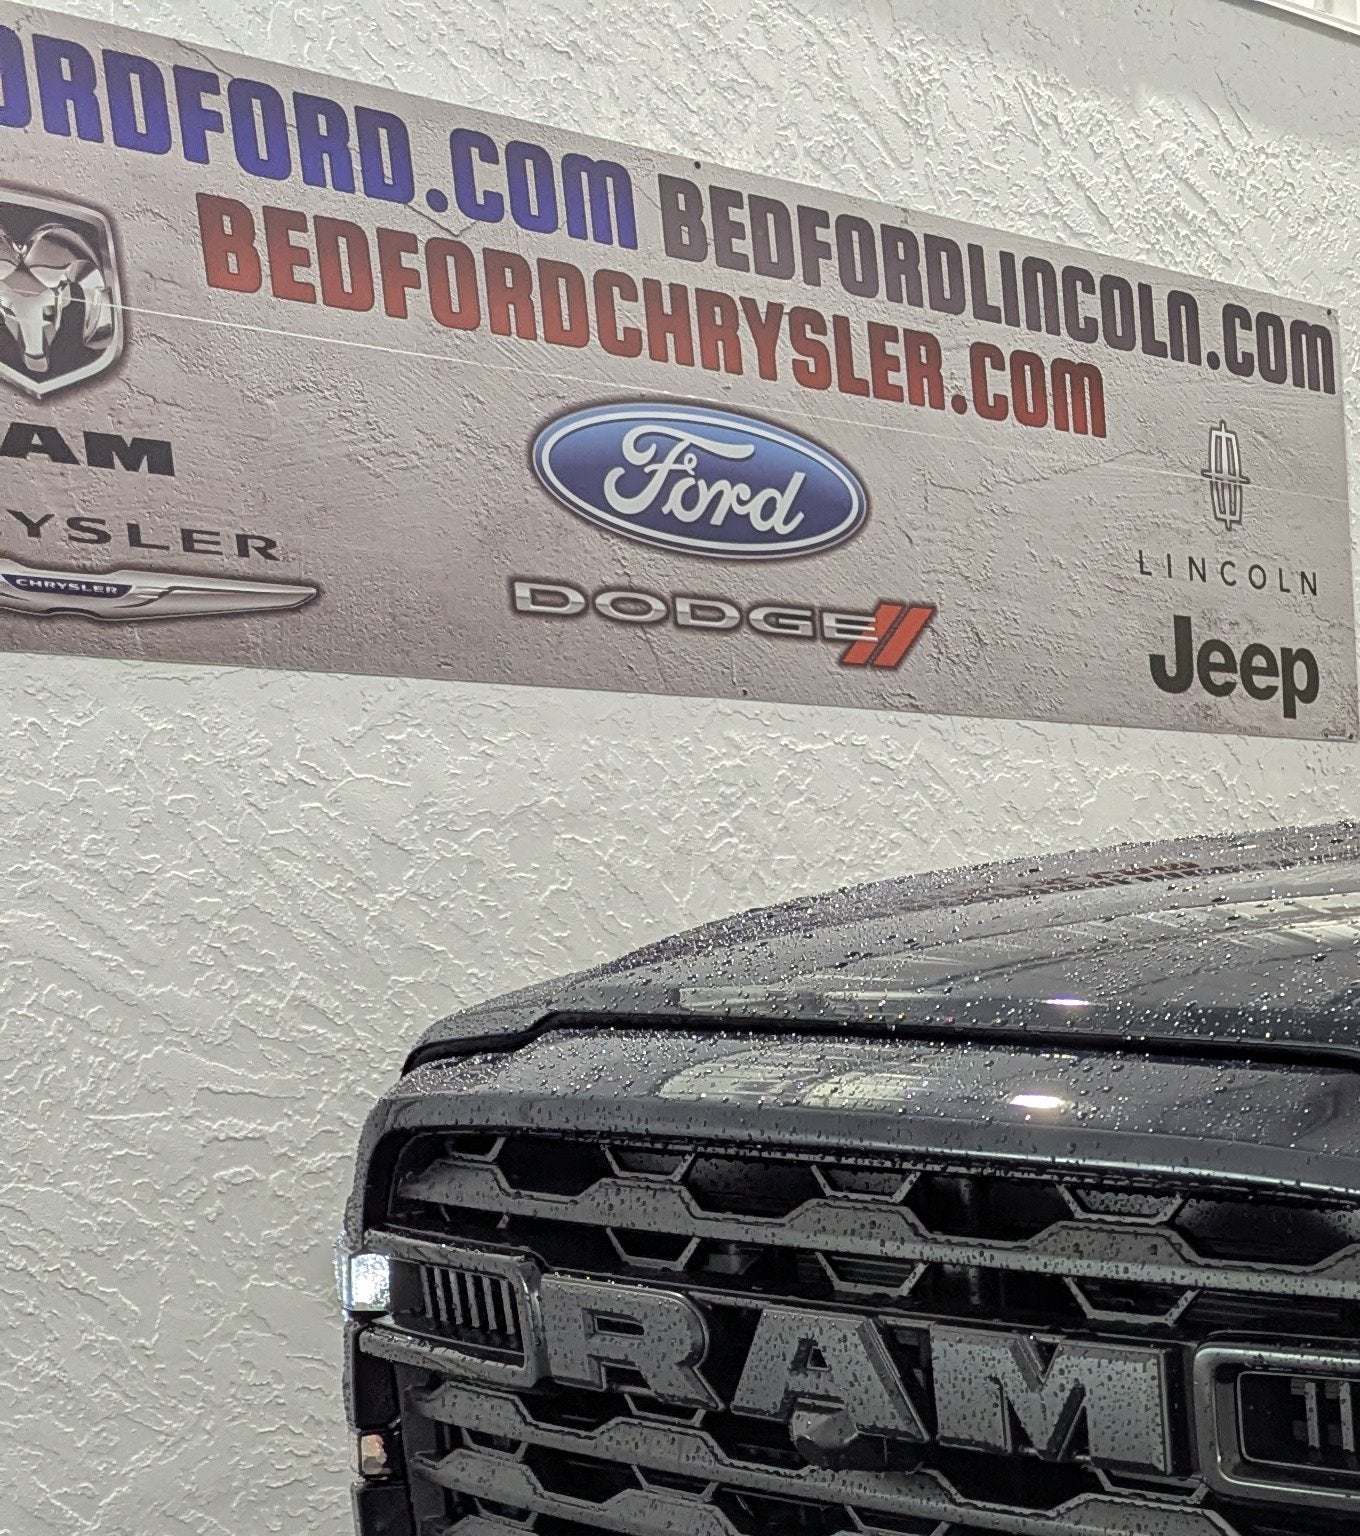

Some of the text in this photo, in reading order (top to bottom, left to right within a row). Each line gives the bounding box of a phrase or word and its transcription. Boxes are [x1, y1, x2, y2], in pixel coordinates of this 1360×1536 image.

[196, 192, 1107, 438] BEDFORDCHRYSLER.COM
[657, 173, 1336, 394] BEDFORDLINCOLN.COM
[604, 424, 805, 536] Ford
[15, 578, 118, 595] CHRYSLER
[513, 581, 879, 643] DODGE
[1138, 549, 1317, 595] LINCOLN
[1149, 614, 1319, 719] Jeep
[540, 1273, 1173, 1474] RAM
